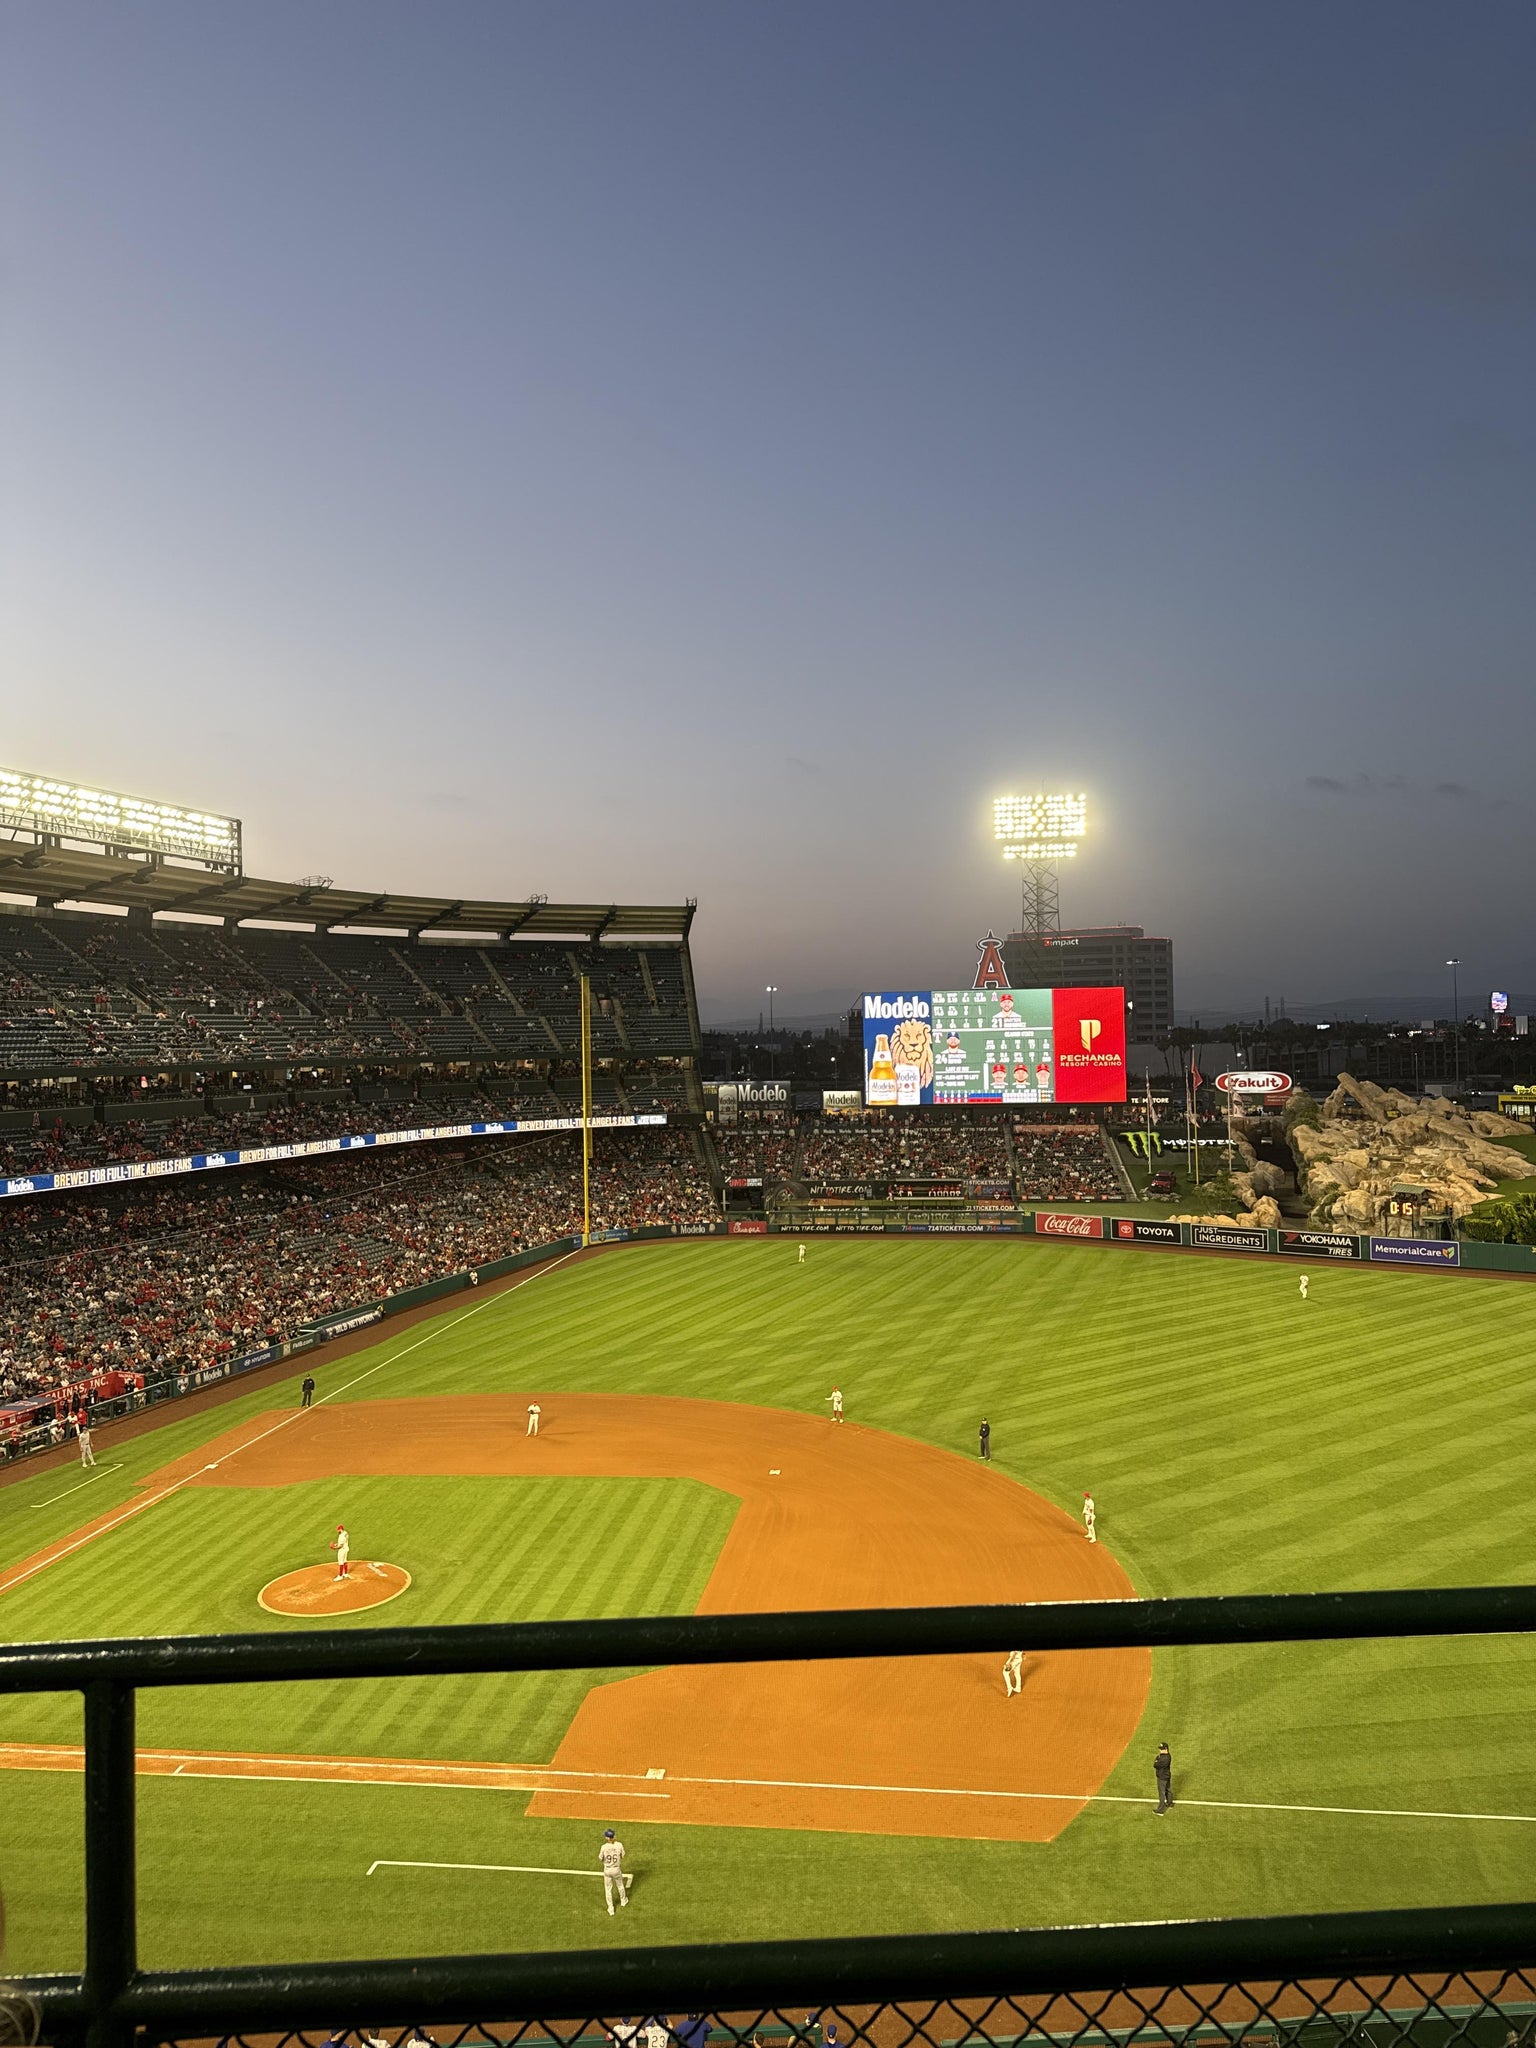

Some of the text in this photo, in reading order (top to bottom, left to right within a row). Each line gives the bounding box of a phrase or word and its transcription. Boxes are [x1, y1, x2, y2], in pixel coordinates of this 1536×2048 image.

[864, 996, 929, 1018] Modelo
[1060, 1054, 1121, 1062] PECHANGA
[1231, 1078, 1280, 1088] Yakult
[738, 1084, 787, 1102] Modelo
[828, 1093, 857, 1105] Modelo
[54, 1157, 192, 1188] BREWED FOR FULL-TIME ANGELS FANS
[8, 1179, 34, 1194] Modelo
[680, 1224, 706, 1235] Modelo
[928, 1224, 984, 1232] 714TICKETS.COM
[1136, 1226, 1174, 1237] TOYOTA
[1199, 1226, 1218, 1234] JUST
[1199, 1233, 1260, 1246] INGREDIENTS
[1300, 1234, 1352, 1247] YOKOHAMA
[1328, 1247, 1353, 1257] TIRES
[1375, 1244, 1442, 1258] MemorialCare
[203, 1368, 222, 1382] Modelo
[652, 2035, 665, 2048] 23
